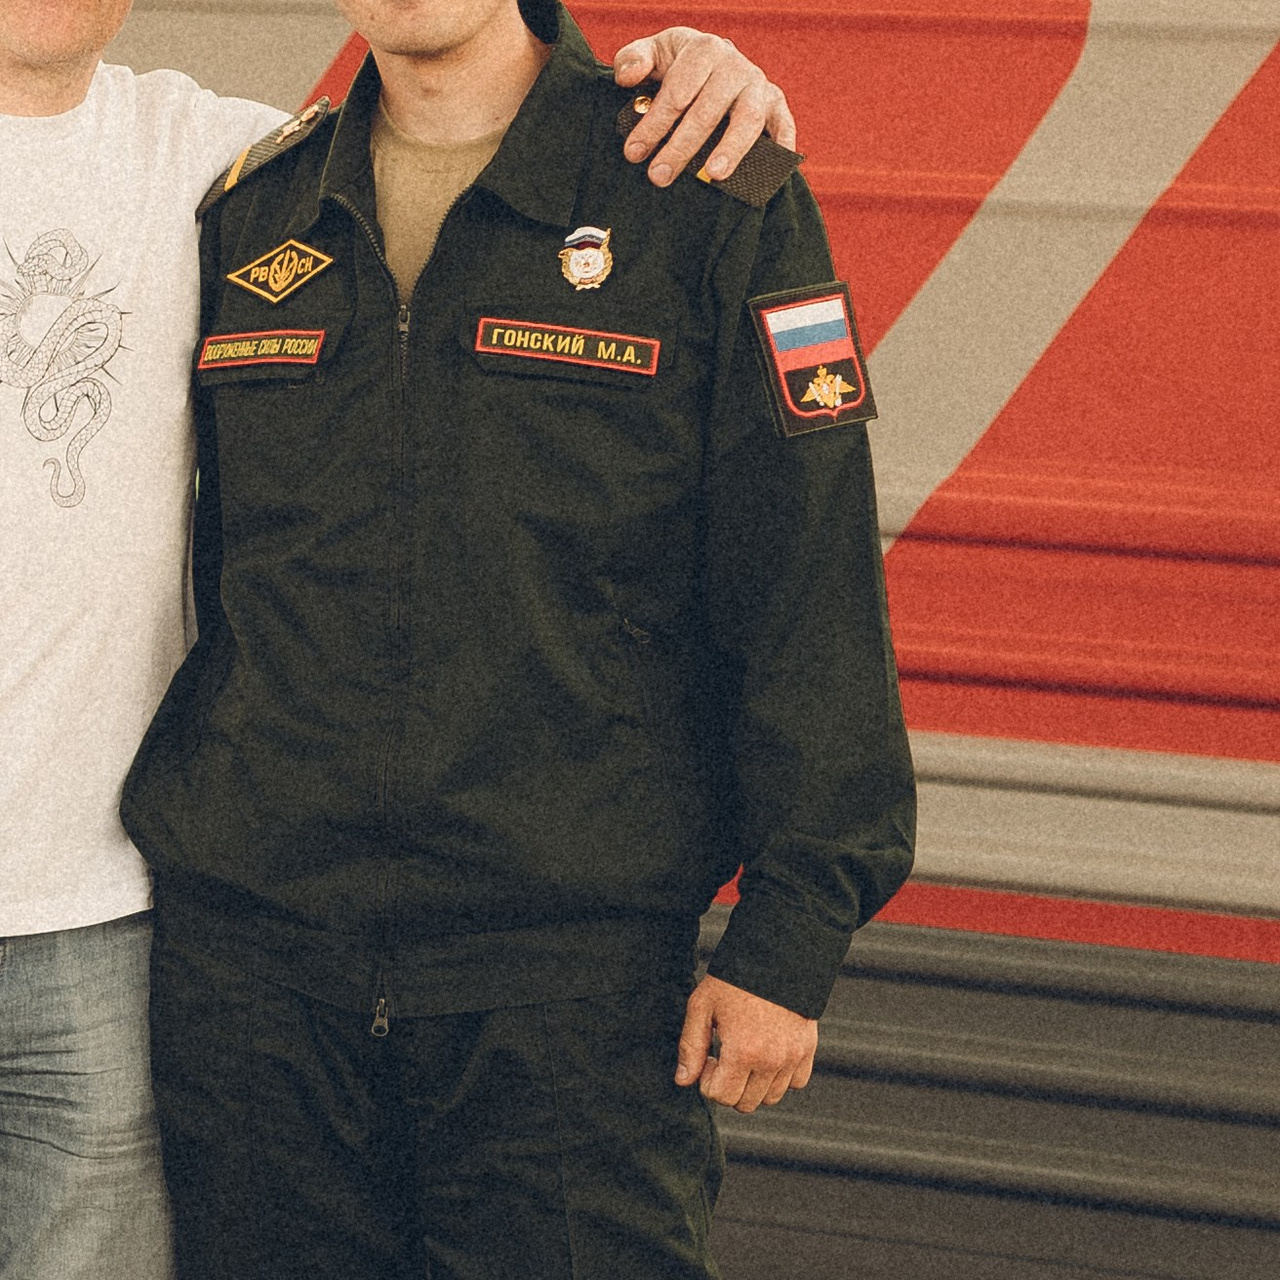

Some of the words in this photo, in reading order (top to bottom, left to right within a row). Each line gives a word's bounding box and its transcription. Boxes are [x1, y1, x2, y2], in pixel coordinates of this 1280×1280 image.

[249, 266, 269, 283] РВ
[297, 255, 314, 274] СН
[281, 338, 319, 355] РОССИИ
[491, 328, 585, 356] ГОНСКИЙ
[597, 340, 642, 364] М.А.
